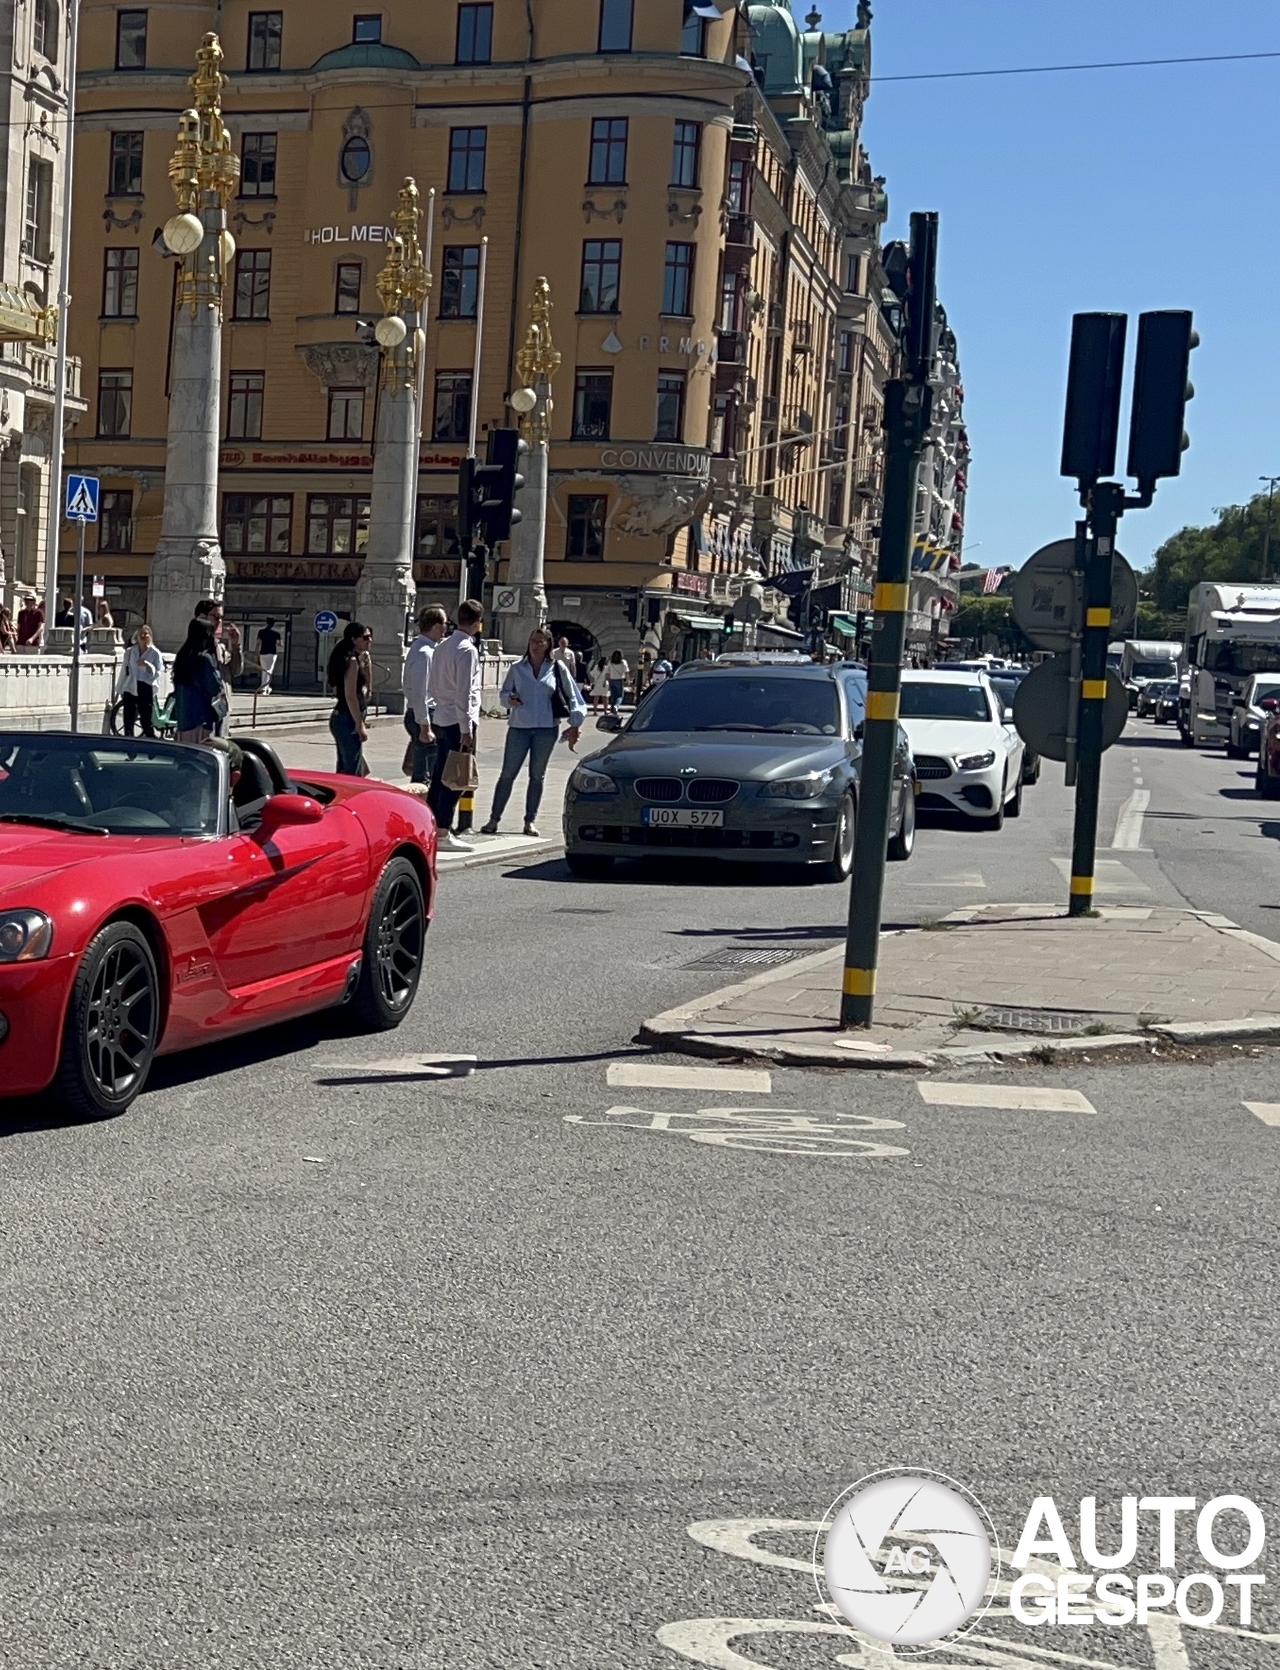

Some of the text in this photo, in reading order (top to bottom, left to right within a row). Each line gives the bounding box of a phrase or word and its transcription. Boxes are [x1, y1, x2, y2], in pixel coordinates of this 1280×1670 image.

[311, 225, 397, 245] HOLMEN
[600, 450, 711, 475] CONVENDUM
[651, 810, 720, 825] UOX 577
